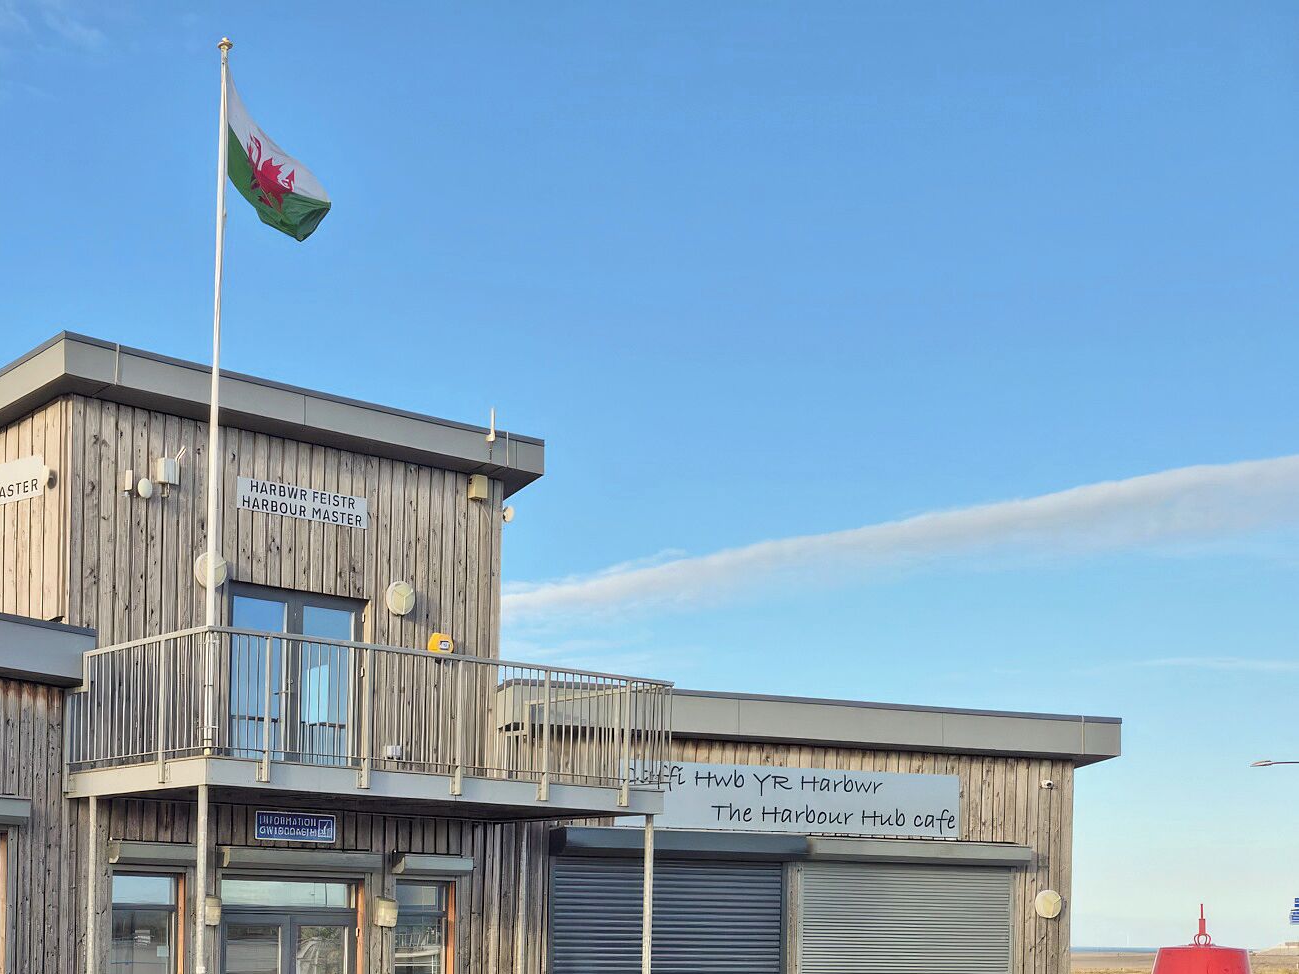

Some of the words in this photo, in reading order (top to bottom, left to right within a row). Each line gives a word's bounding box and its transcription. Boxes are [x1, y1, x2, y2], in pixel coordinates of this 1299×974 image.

[250, 480, 308, 501] HARBWR
[312, 491, 356, 509] FEISTR
[242, 495, 307, 517] HARBOUR
[312, 508, 362, 527] MASTER
[695, 769, 745, 788] Hwb
[753, 773, 793, 797] YR
[801, 774, 884, 794] Harbwr
[711, 803, 752, 823] The
[762, 804, 854, 825] Harbour
[861, 808, 906, 827] Hub
[914, 809, 956, 835] cafe
